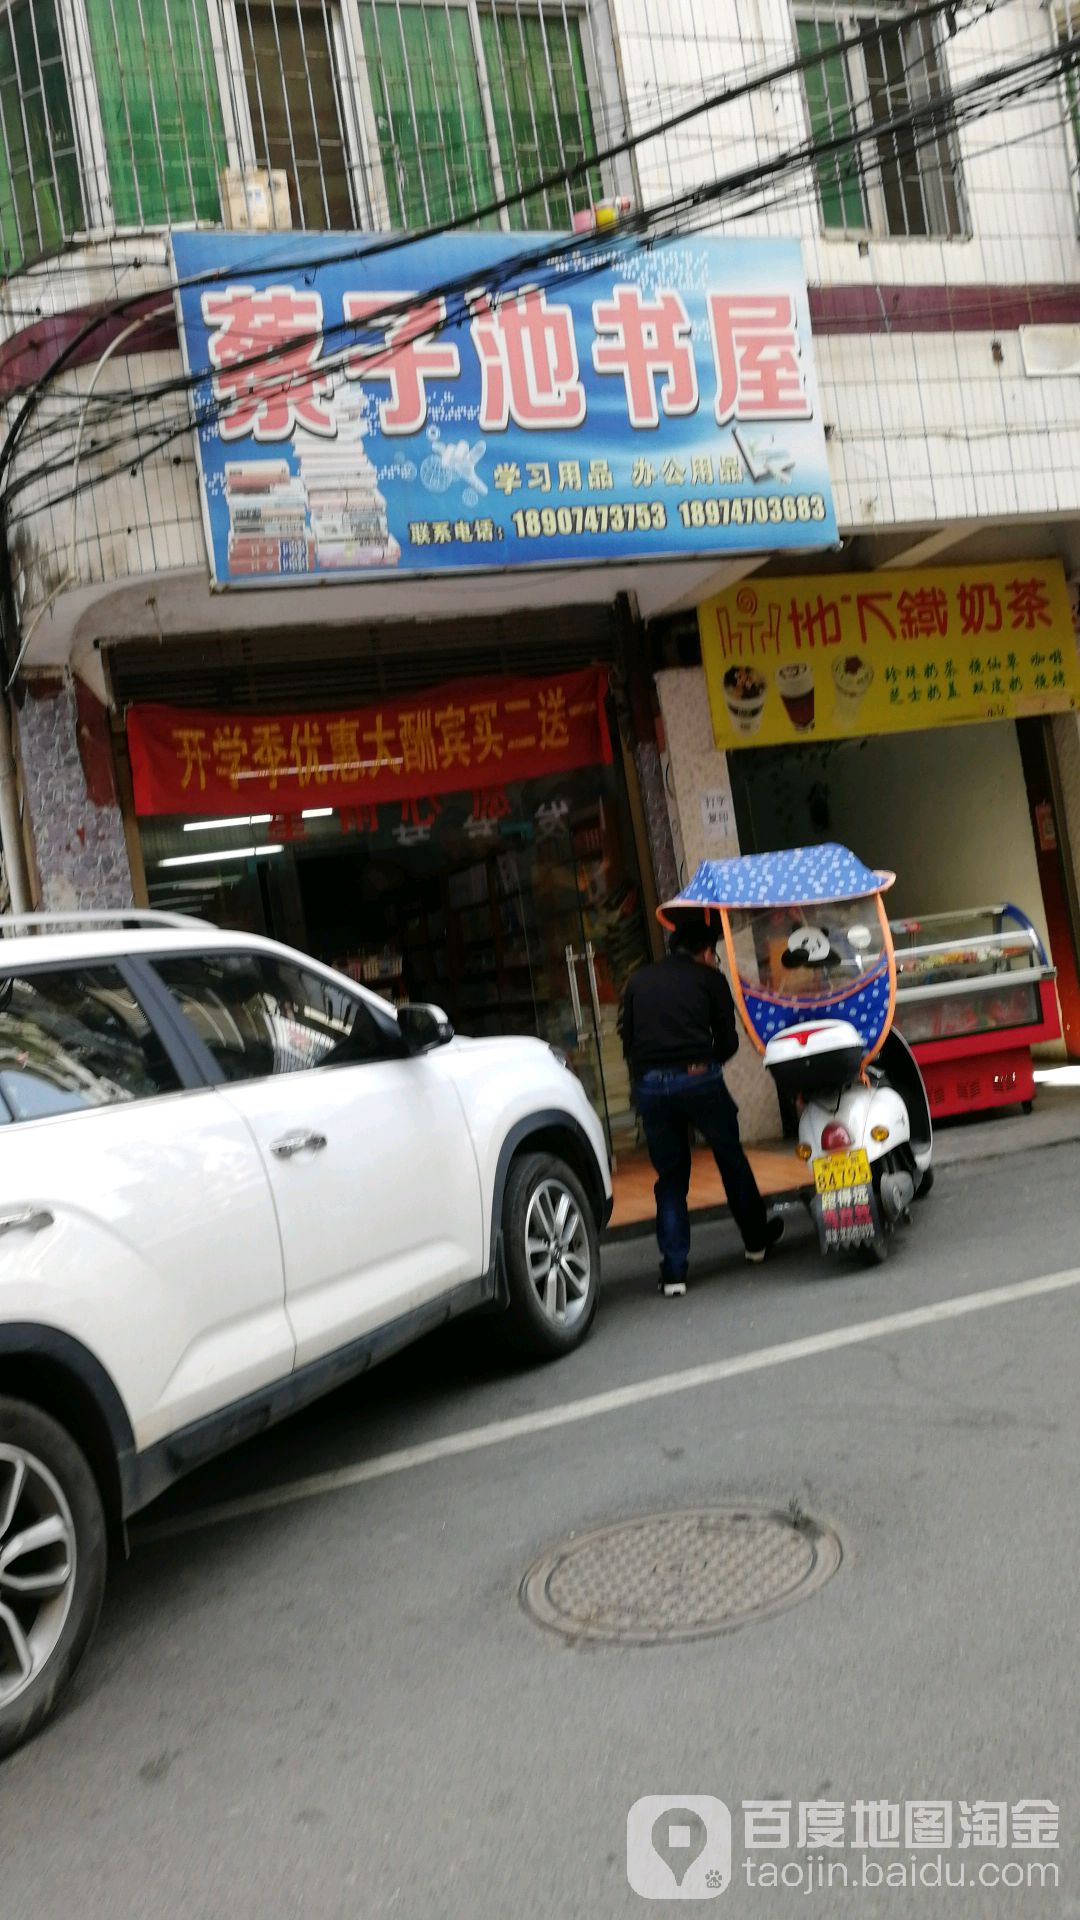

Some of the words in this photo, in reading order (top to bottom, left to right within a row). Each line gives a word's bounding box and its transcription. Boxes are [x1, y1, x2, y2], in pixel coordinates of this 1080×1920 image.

[200, 283, 813, 441] 蔡子池书屋
[493, 460, 614, 495] 学习用品
[632, 455, 745, 488] 办公用品
[512, 502, 667, 539] 18907473753
[172, 687, 597, 791] 开学季优惠大酬宾买二送一
